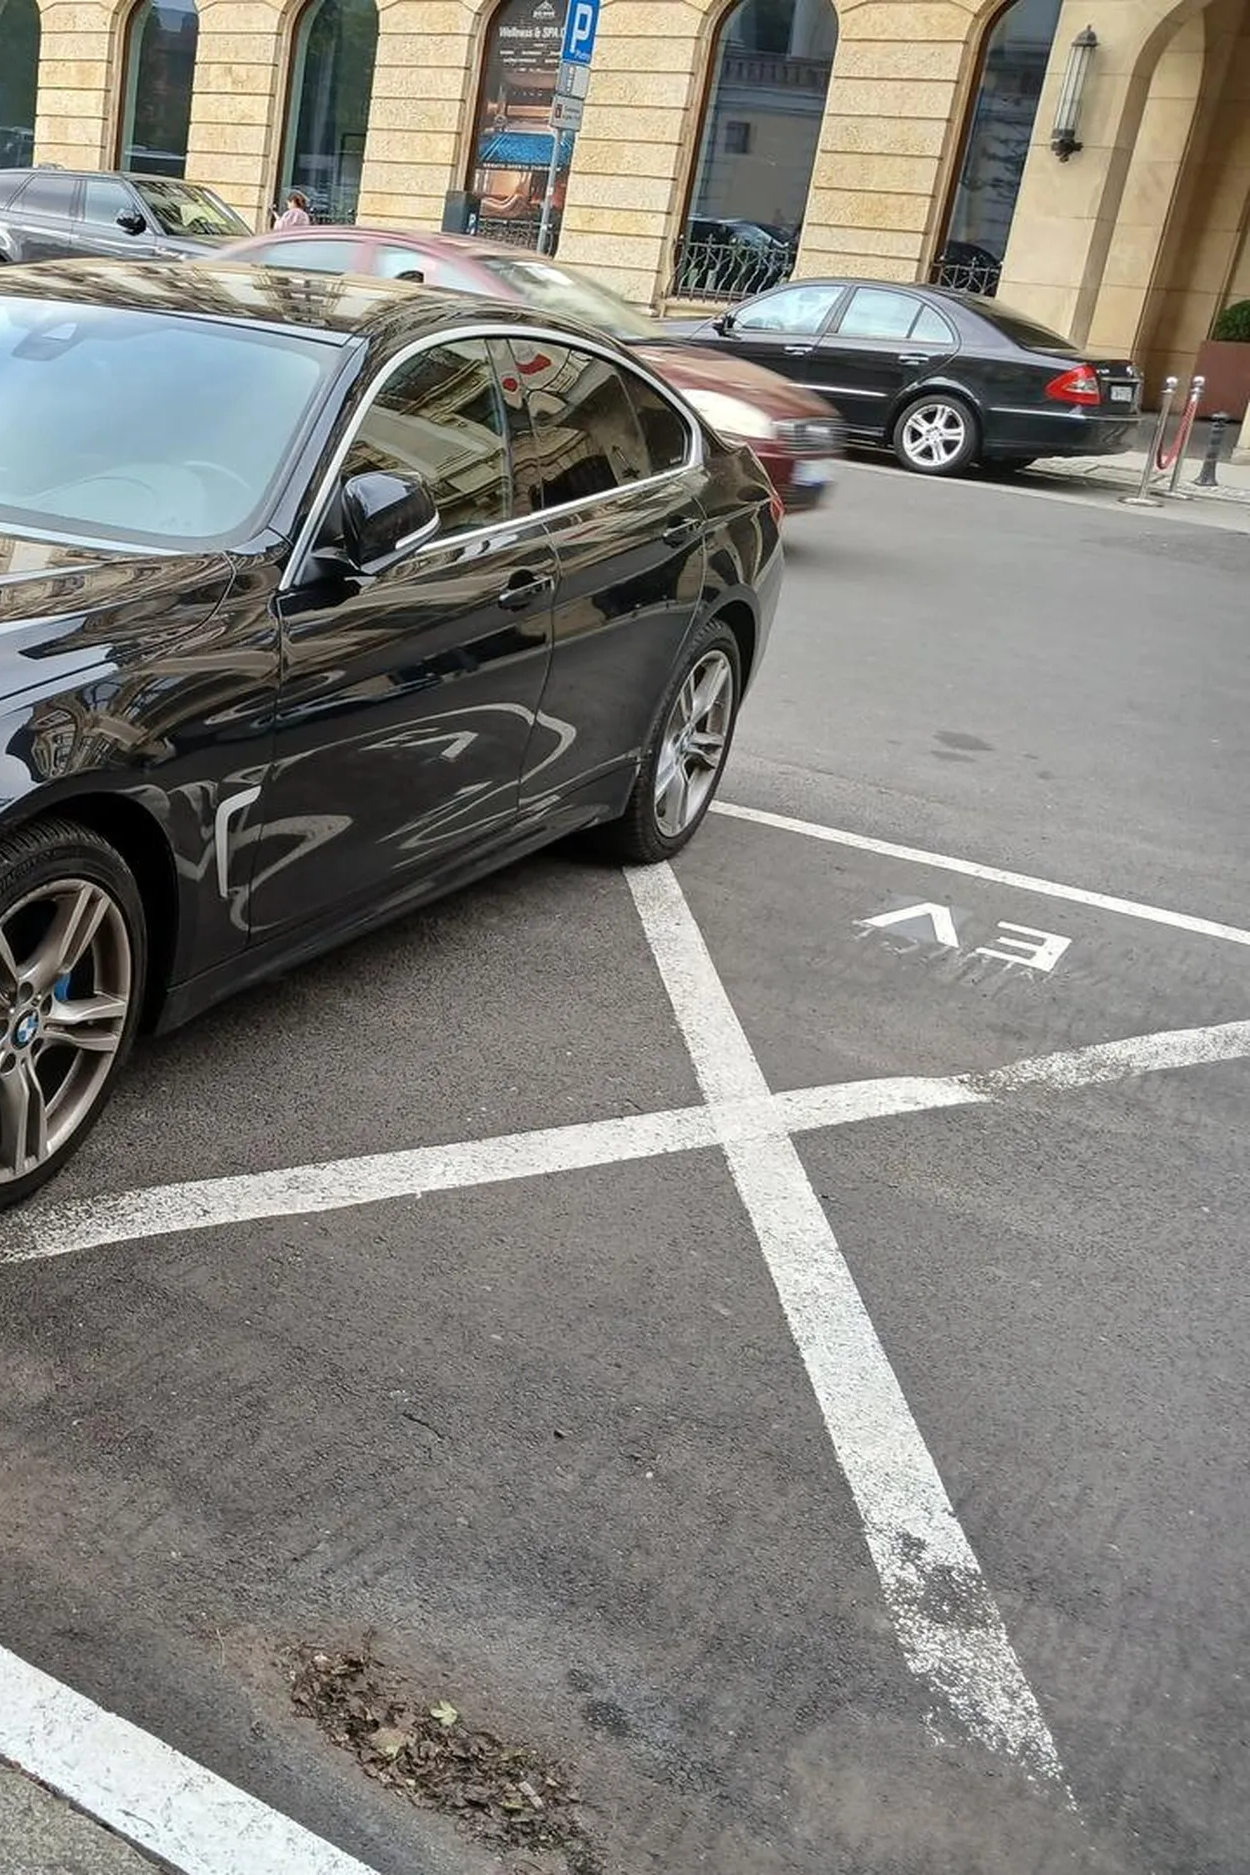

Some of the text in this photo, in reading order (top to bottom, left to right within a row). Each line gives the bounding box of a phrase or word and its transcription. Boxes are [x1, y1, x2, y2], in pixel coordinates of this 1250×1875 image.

[499, 26, 533, 38] Wellness
[542, 26, 559, 39] SPA
[570, 3, 593, 54] P
